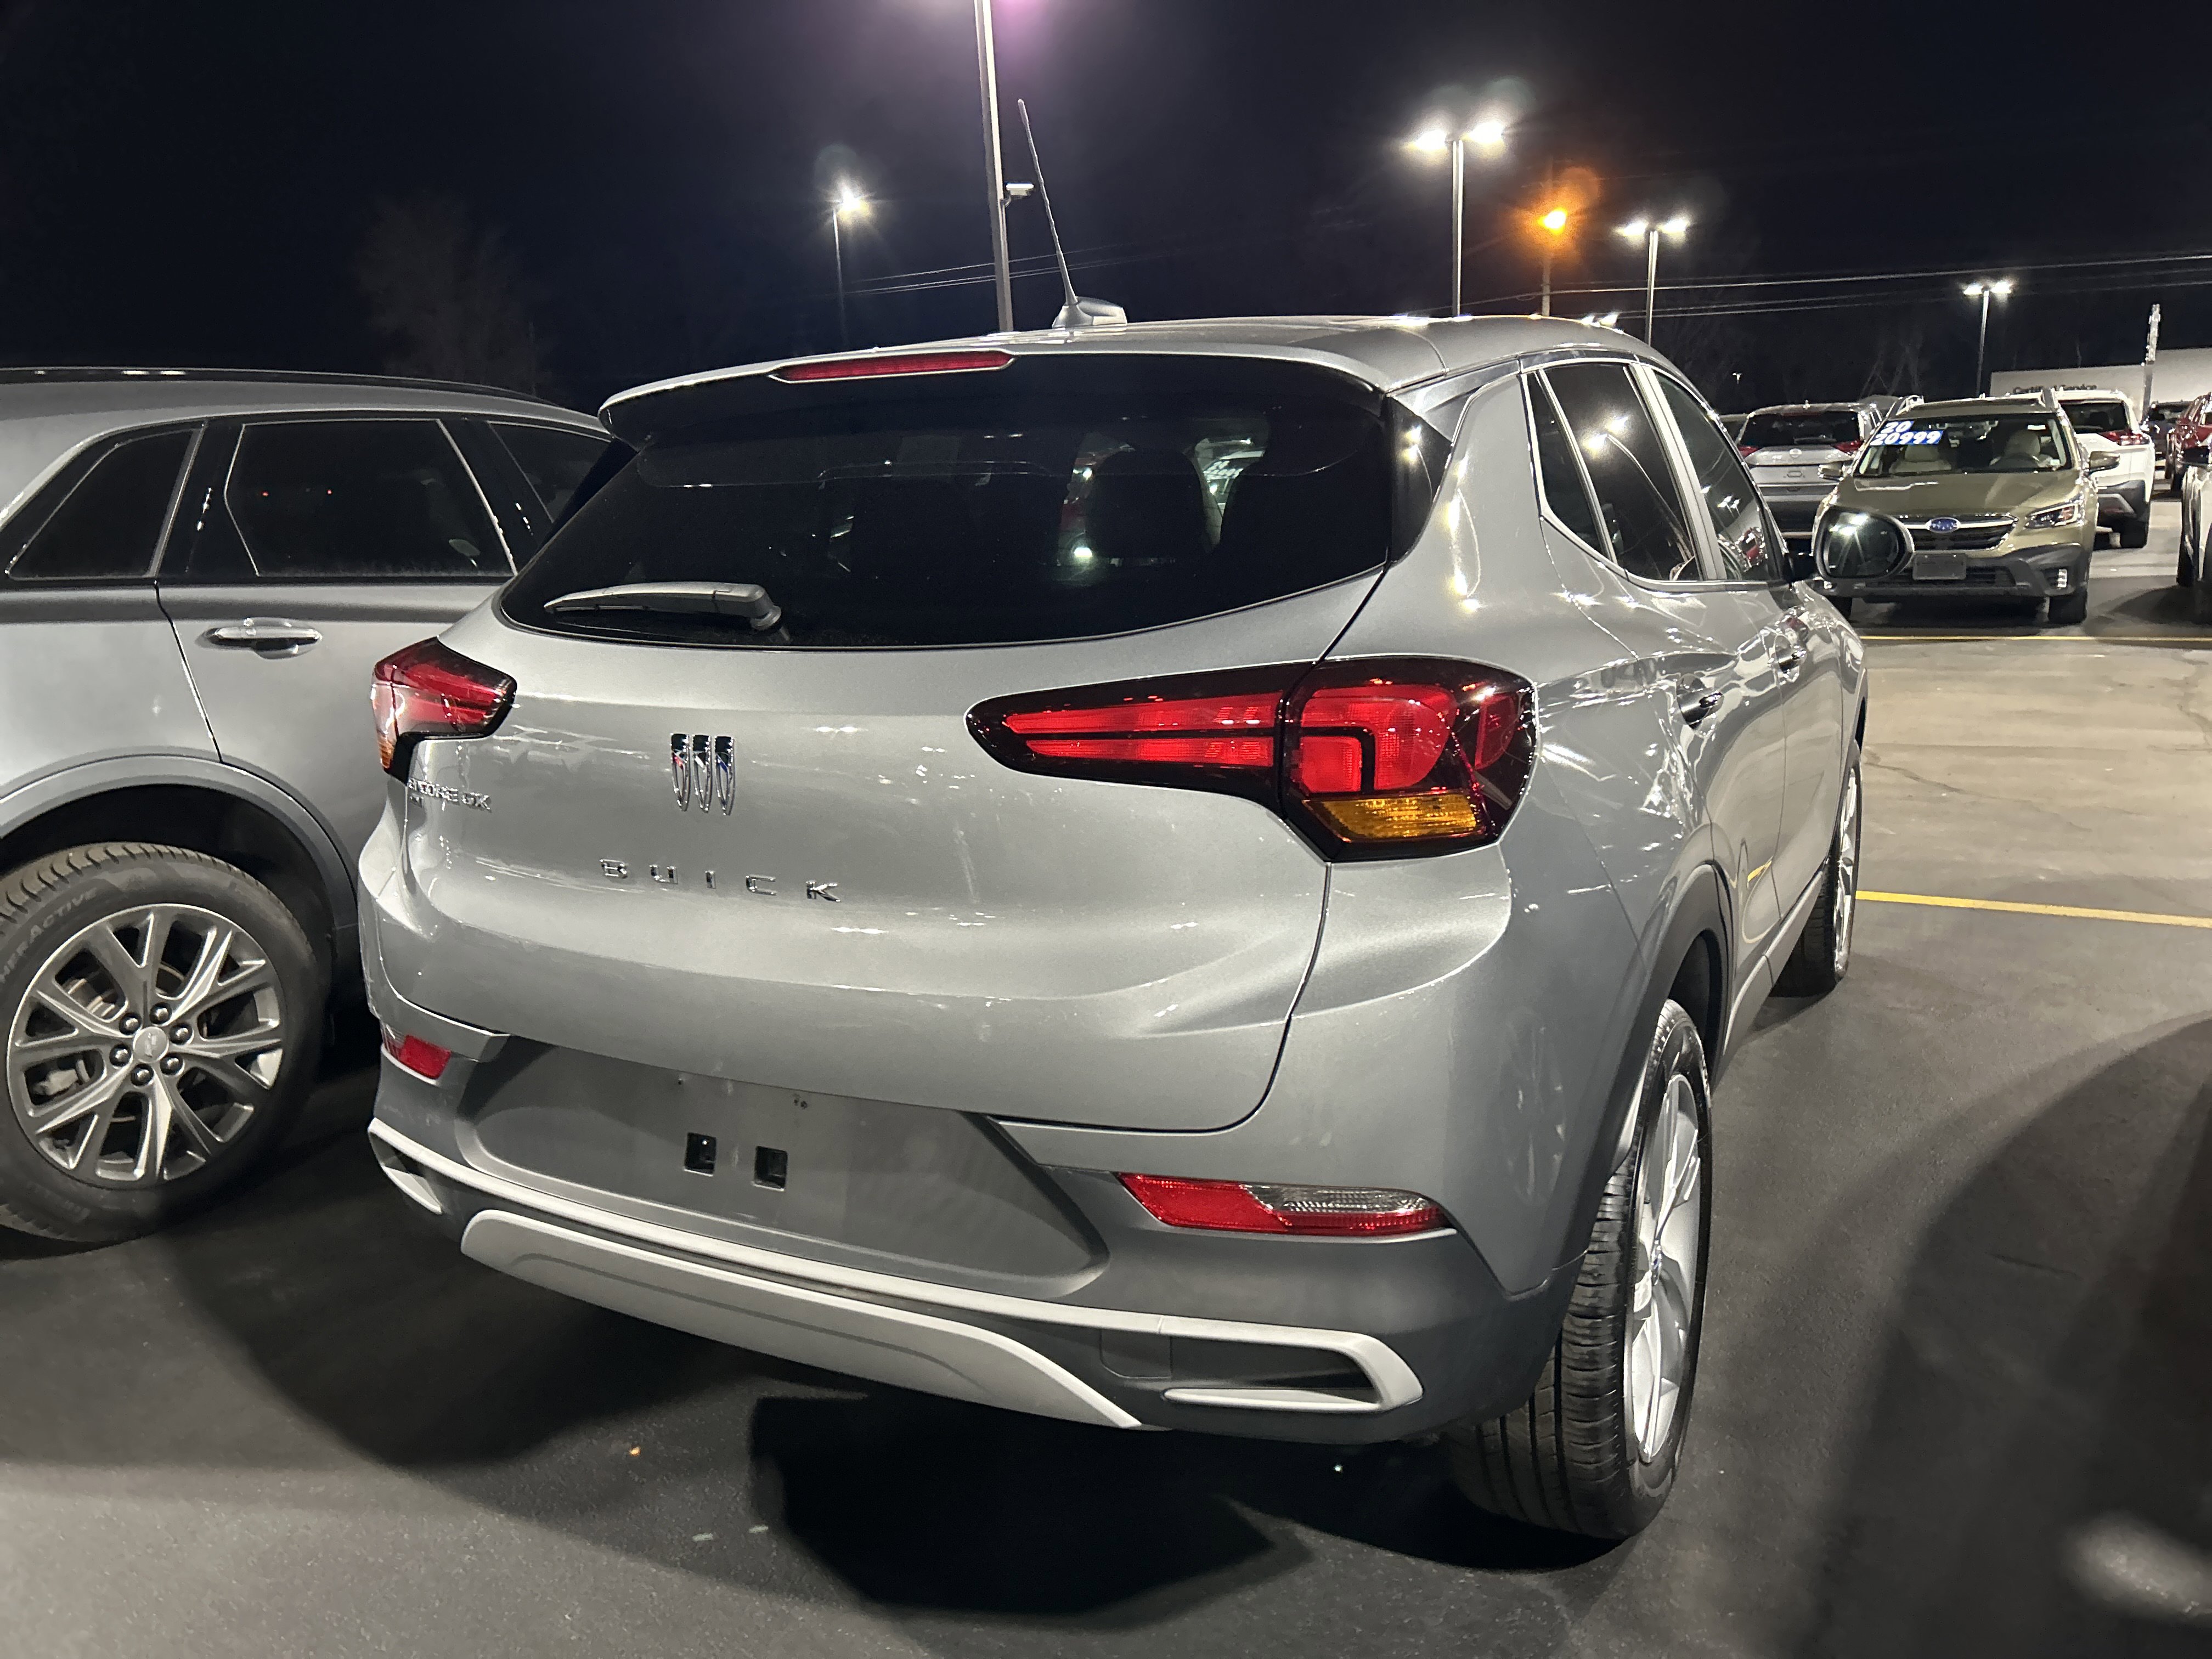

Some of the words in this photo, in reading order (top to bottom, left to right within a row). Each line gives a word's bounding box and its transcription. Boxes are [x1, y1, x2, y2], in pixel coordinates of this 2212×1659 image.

[1881, 421, 1912, 433] 20
[1870, 431, 1941, 445] 20999
[600, 858, 841, 902] BUICK
